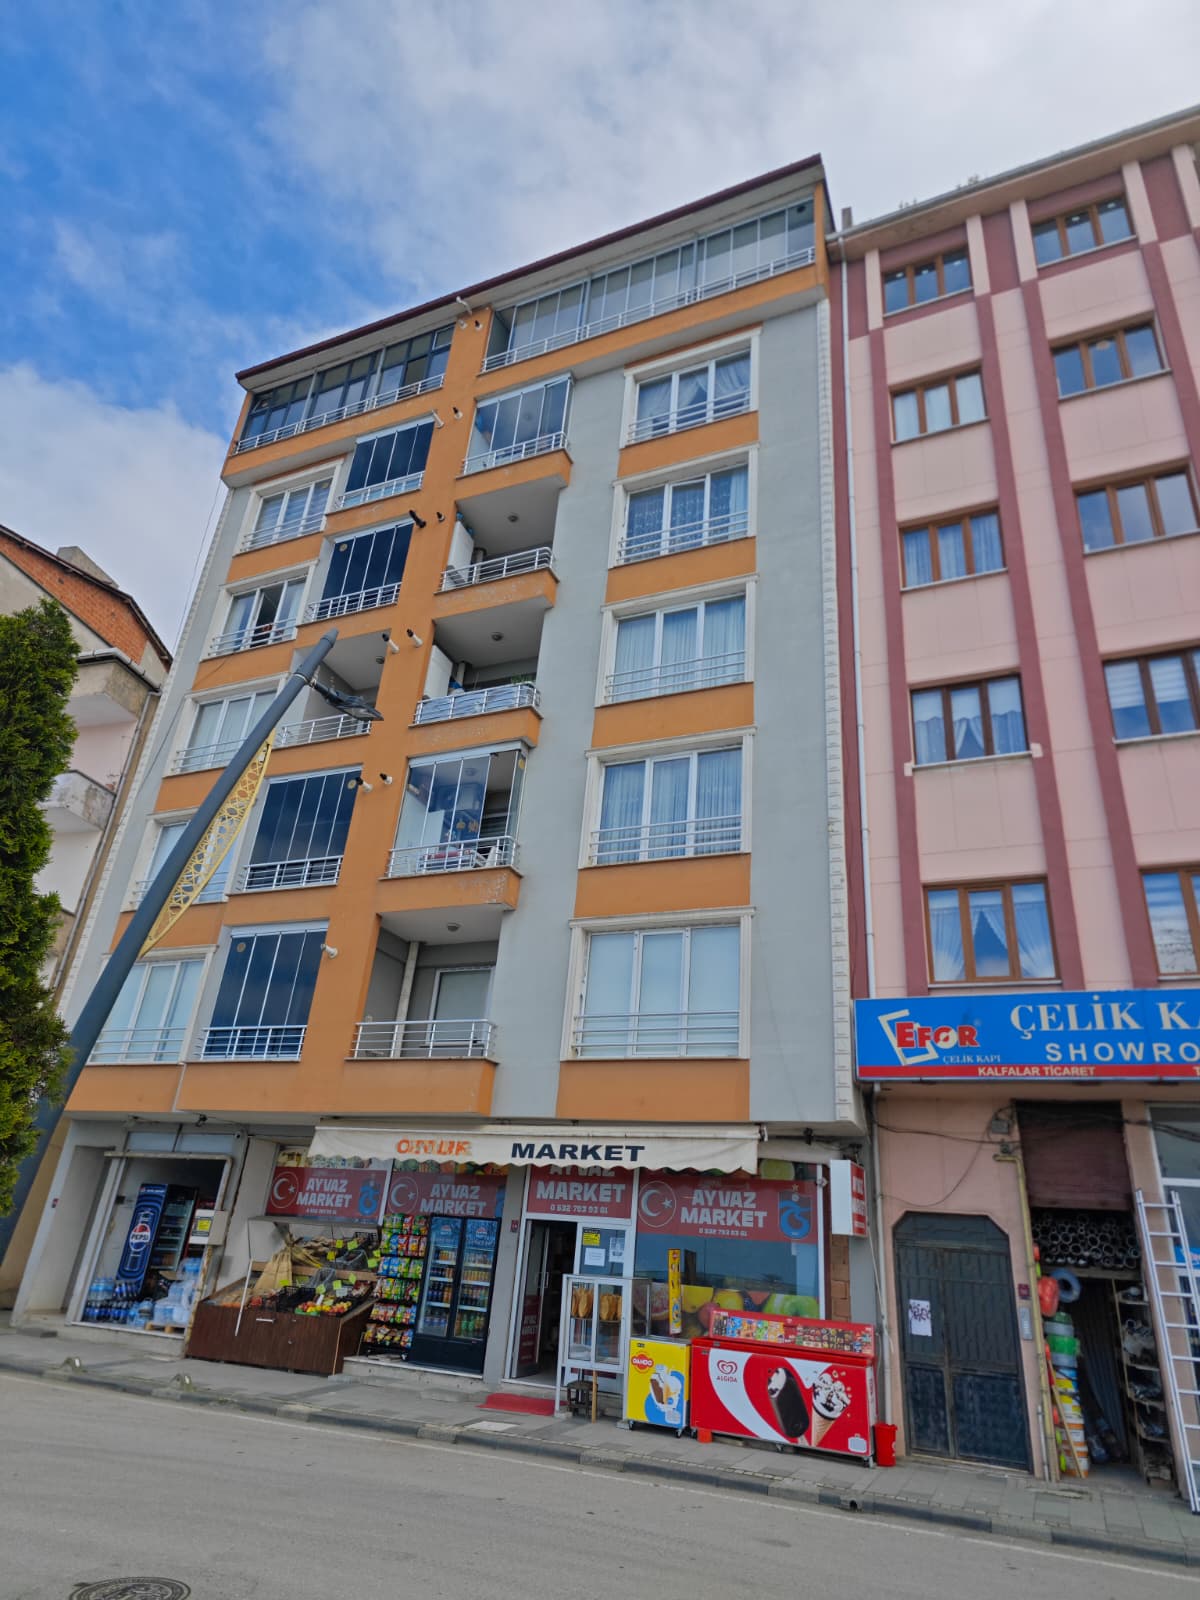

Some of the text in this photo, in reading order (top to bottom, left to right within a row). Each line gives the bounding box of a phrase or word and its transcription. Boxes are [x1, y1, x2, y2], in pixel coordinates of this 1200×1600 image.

[1010, 994, 1200, 1039] ÇELİK K
[943, 1053, 1001, 1064] ÇELİK KAPI
[978, 1066, 1041, 1076] KALFALAR
[1043, 1064, 1095, 1076] TİCARET
[511, 1143, 645, 1162] MARKET
[306, 1177, 348, 1193] AYVAZ
[430, 1183, 480, 1199] AYVAZ
[536, 1181, 625, 1203] MARKET
[296, 1192, 353, 1209] MARKET
[420, 1198, 487, 1217] MARKET
[692, 1189, 756, 1209] AYVAZ
[680, 1207, 768, 1229] MARKET
[716, 1375, 738, 1383] ALGIDA
